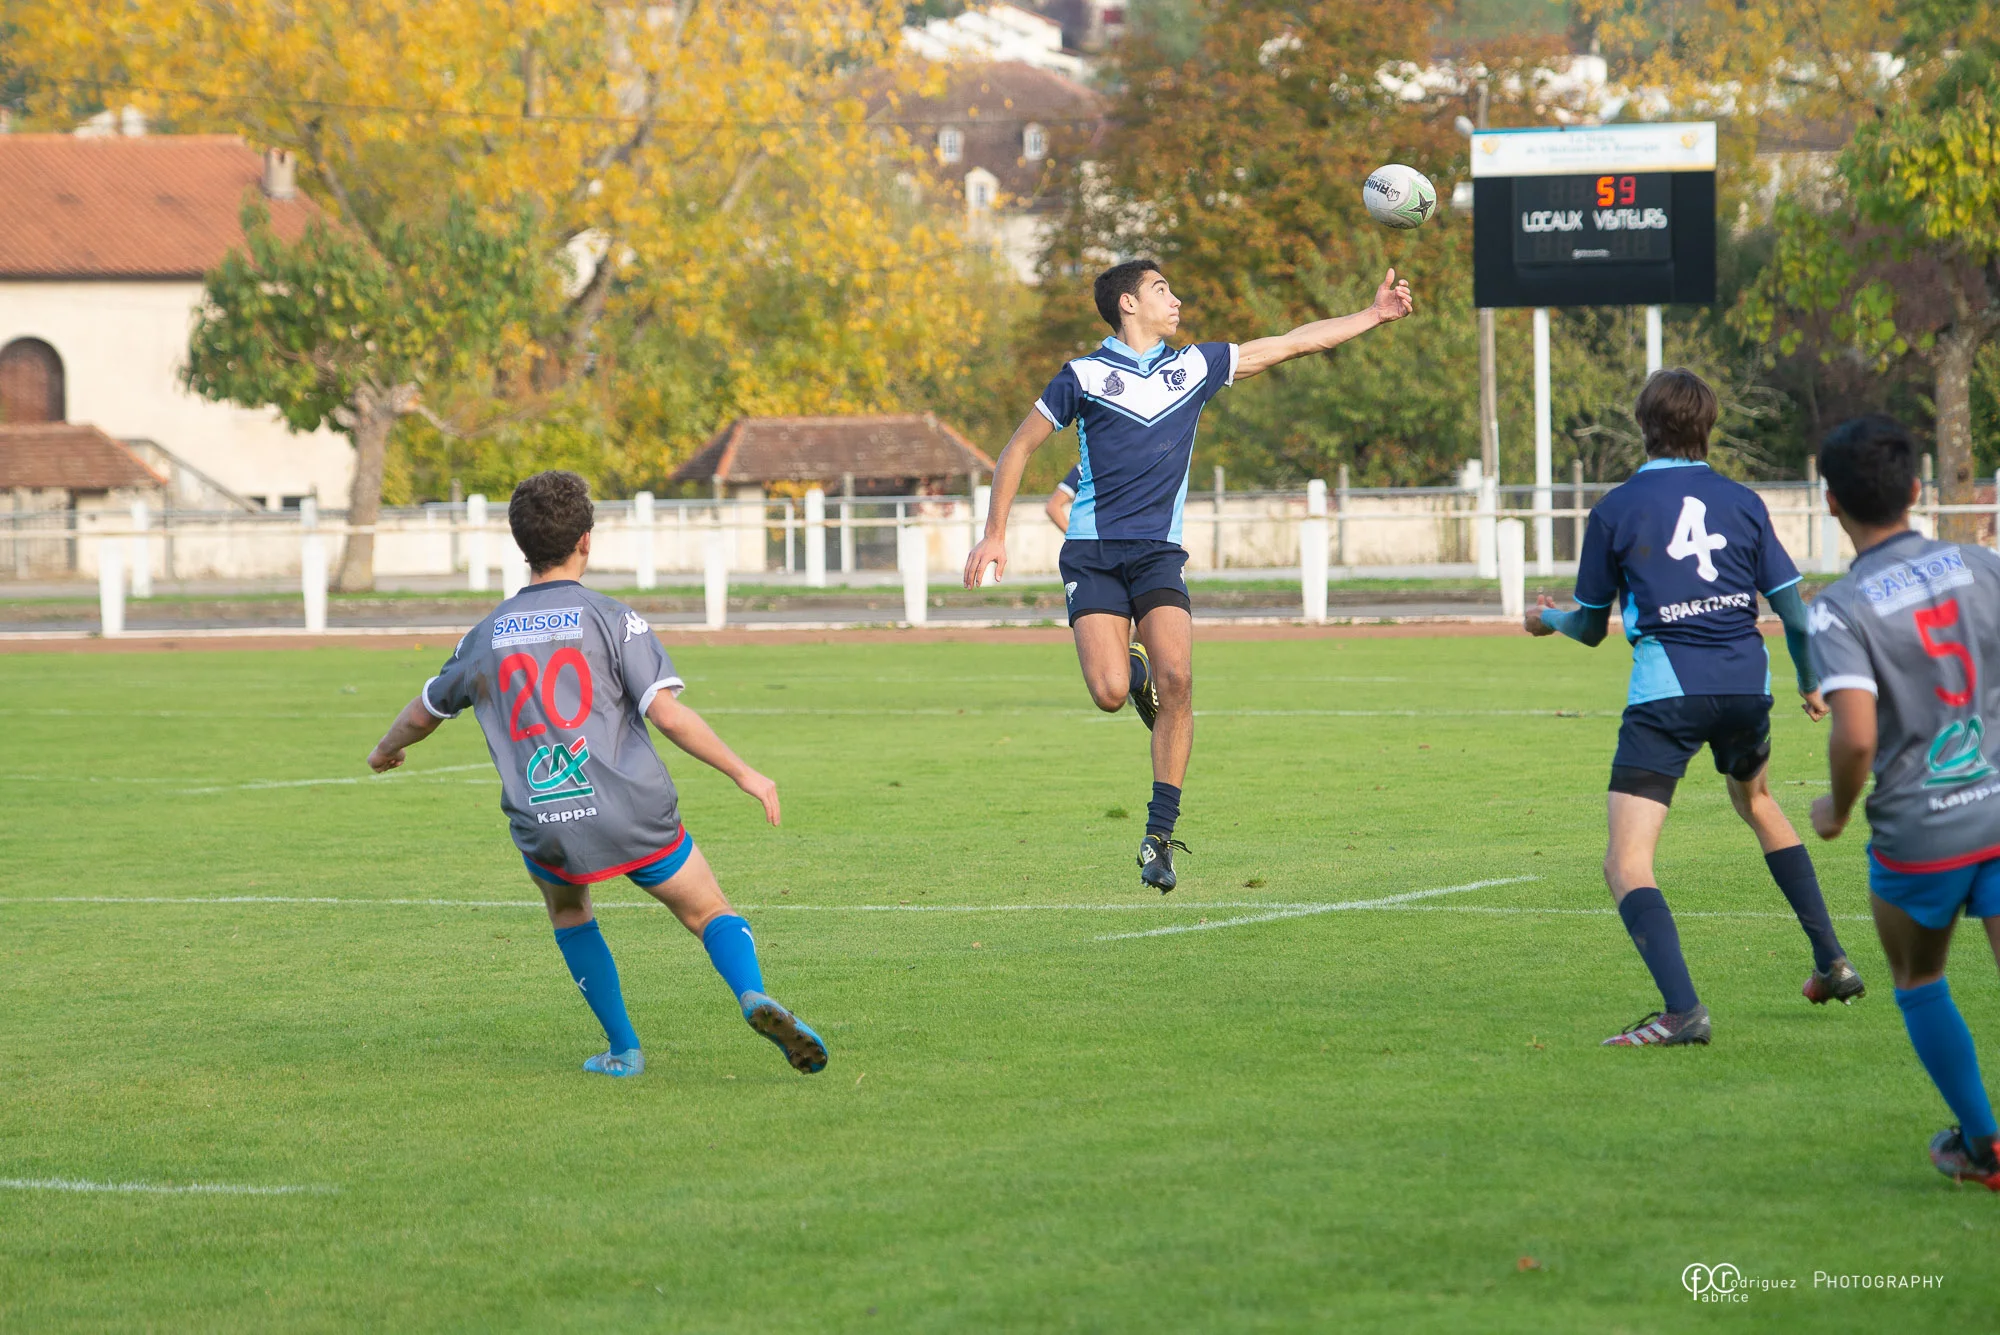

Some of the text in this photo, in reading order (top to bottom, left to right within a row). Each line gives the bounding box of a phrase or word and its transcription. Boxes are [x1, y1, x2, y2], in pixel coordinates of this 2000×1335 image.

[1364, 179, 1390, 195] RHIN
[1522, 208, 1667, 232] LOCAUX VISITEURS
[1667, 496, 1727, 582] 4
[1864, 553, 1965, 601] SALSON
[493, 612, 580, 637] SALSON
[1914, 598, 1977, 708] 5
[498, 647, 593, 742] 20
[537, 807, 597, 824] Kappa
